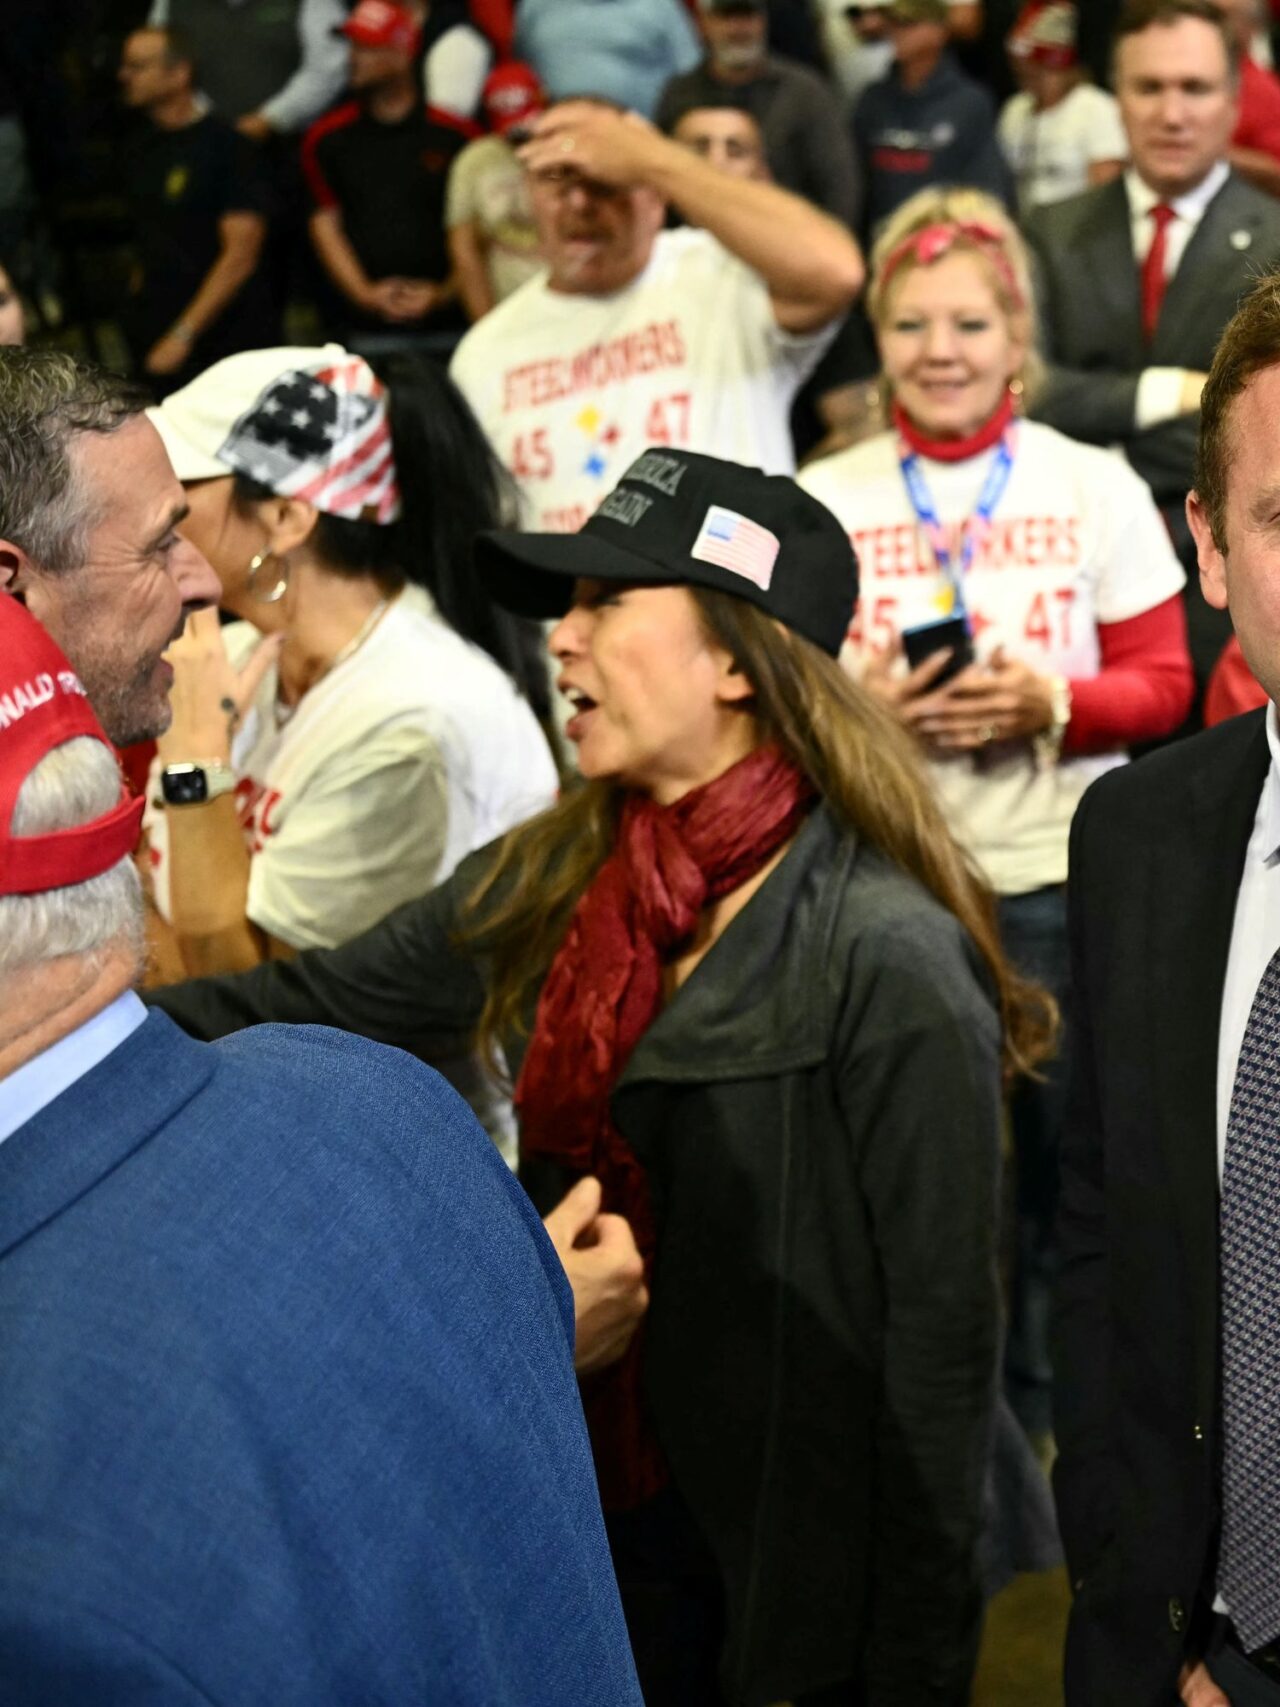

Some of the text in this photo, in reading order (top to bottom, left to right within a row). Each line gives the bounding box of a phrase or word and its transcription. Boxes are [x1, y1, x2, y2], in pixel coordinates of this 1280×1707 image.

[503, 317, 688, 416] STEELWORKERS
[512, 391, 691, 480] 45 47
[1024, 587, 1076, 654] 47
